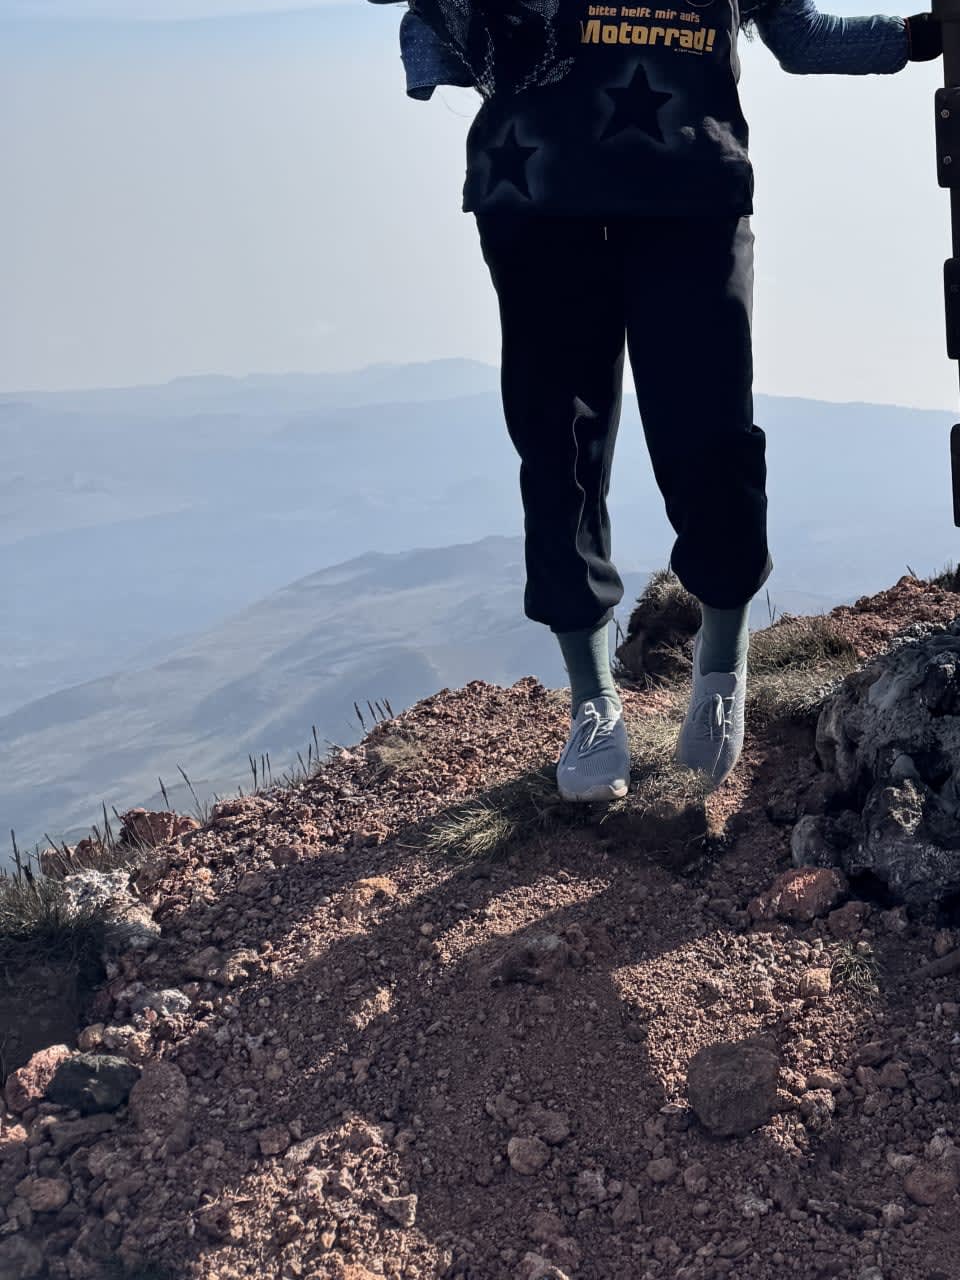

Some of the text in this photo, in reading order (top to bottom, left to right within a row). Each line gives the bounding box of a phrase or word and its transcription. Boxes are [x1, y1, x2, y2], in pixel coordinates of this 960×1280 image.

[588, 5, 617, 17] bitte
[621, 6, 651, 18] helft
[655, 8, 677, 20] mir
[580, 19, 716, 52] Motorrad!
